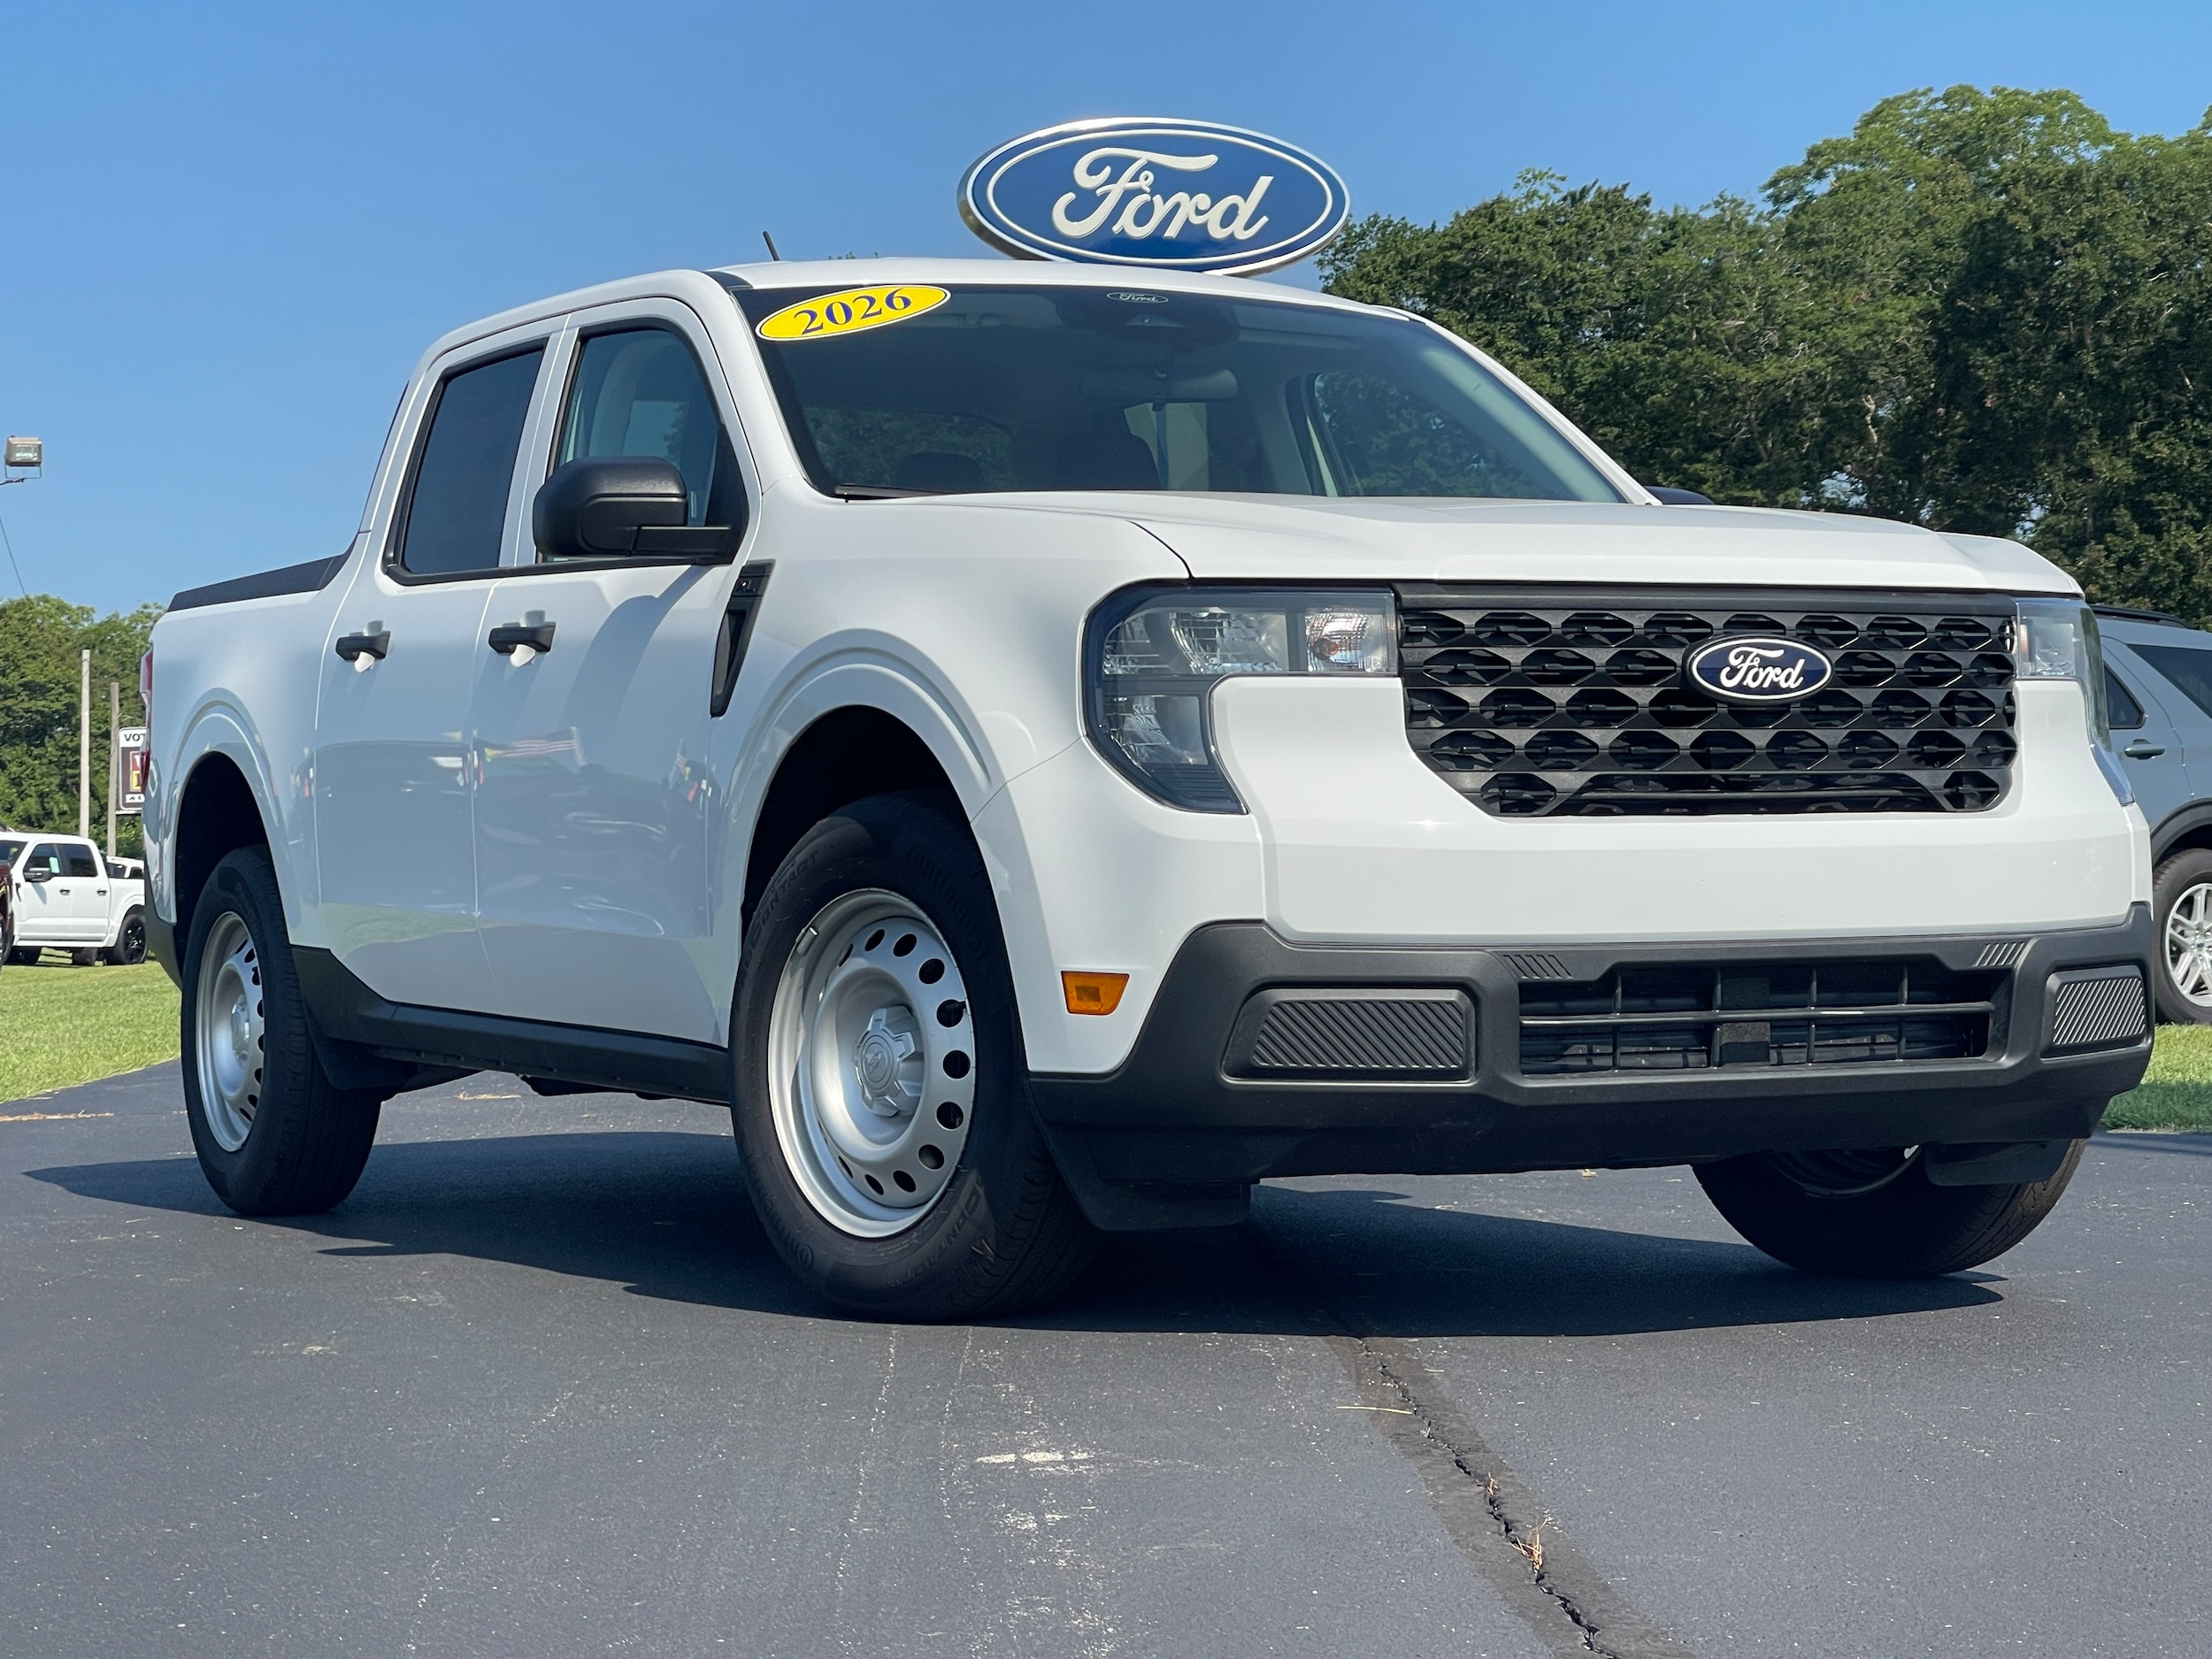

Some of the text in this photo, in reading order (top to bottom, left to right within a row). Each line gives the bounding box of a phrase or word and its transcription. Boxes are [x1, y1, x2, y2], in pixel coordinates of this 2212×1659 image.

[1052, 147, 1274, 240] Ford
[794, 288, 911, 335] 2026
[1119, 293, 1158, 302] Ford
[1719, 646, 1806, 689] Ford
